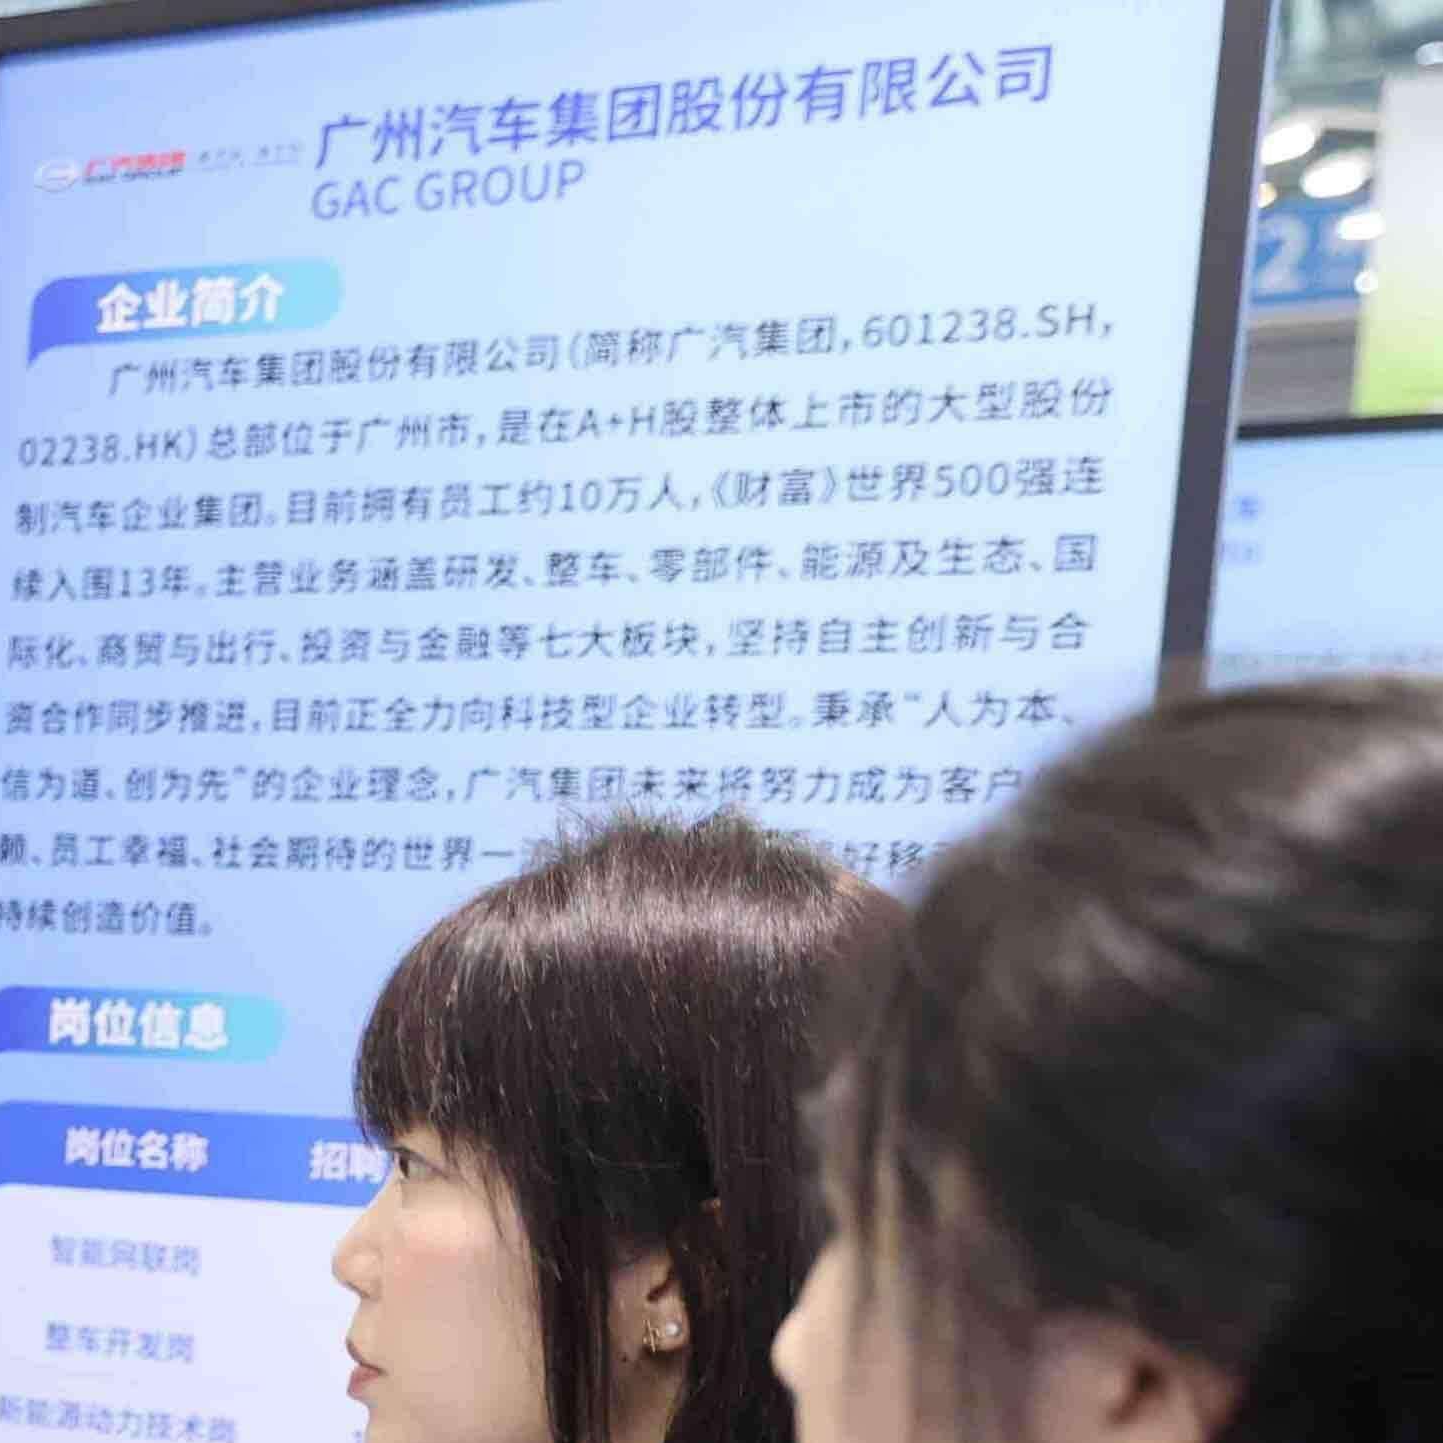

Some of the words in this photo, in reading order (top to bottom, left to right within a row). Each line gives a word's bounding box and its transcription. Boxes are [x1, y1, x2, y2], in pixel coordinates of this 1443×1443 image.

[314, 44, 1054, 168] 广州汽车集团股份有限公司
[310, 175, 400, 221] GAC
[414, 159, 586, 214] GROUP
[95, 274, 286, 336] 企业简介
[0, 765, 1034, 803] 信为道、创为先”的企业理念，广汽集团未来将努力成为客户
[49, 997, 229, 1049] 岗位信息
[64, 1127, 210, 1173] 岗位名称
[49, 1234, 203, 1277] 智能网联岗
[44, 1321, 196, 1364] 整车开发岗
